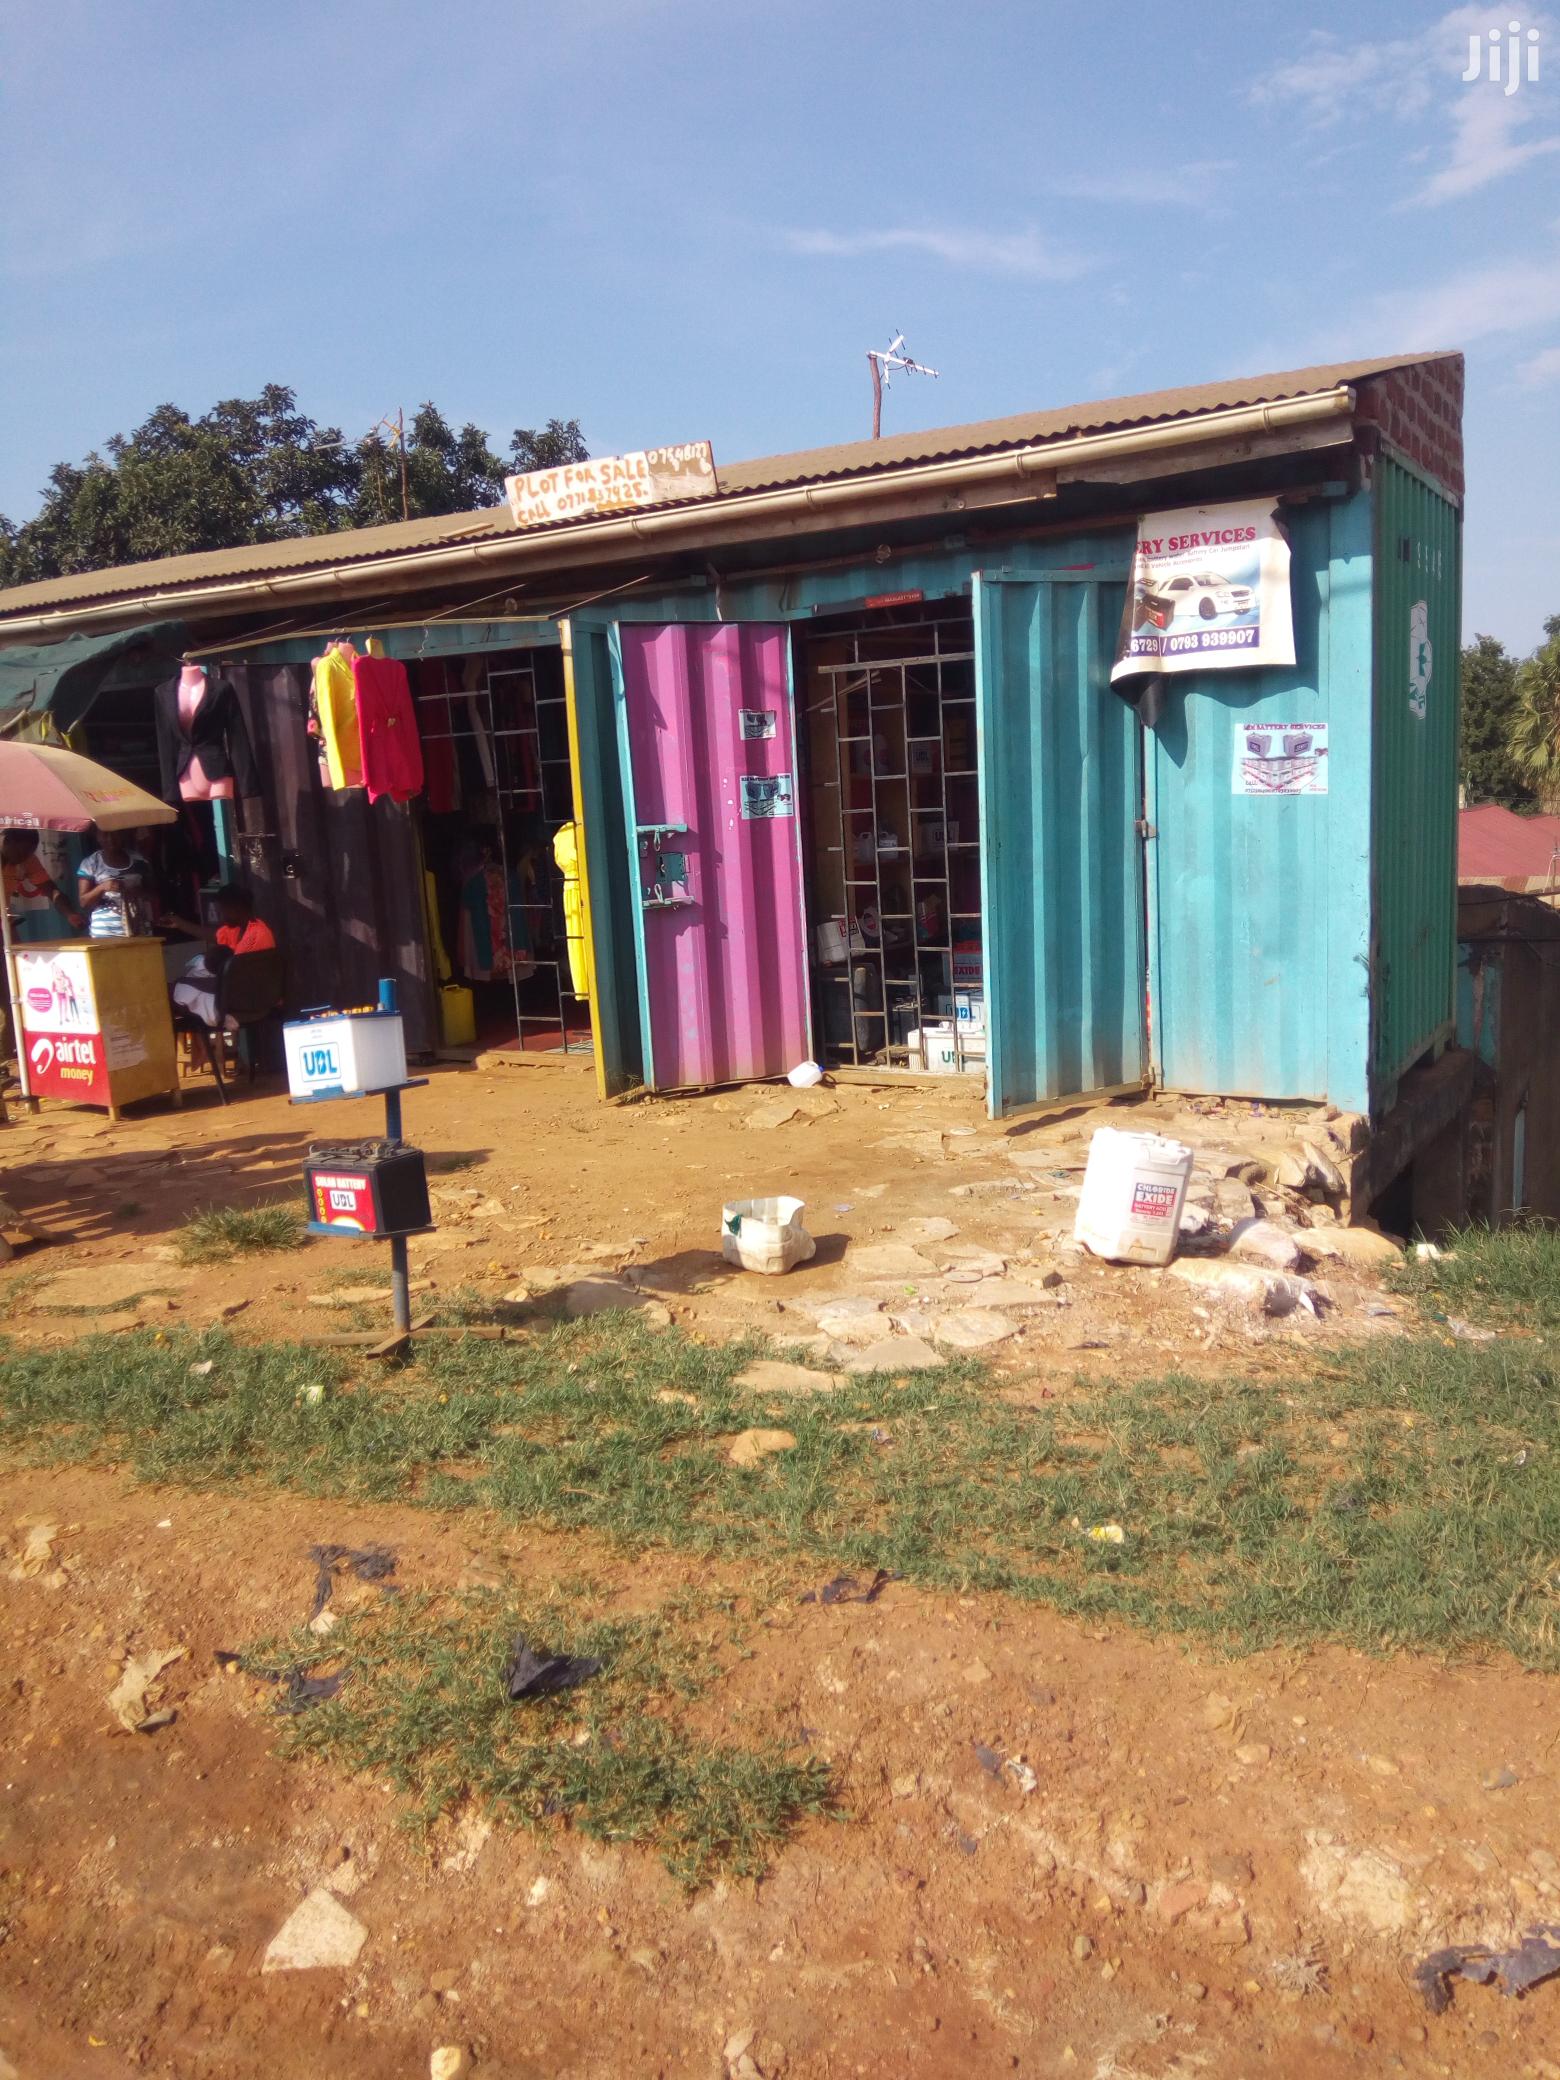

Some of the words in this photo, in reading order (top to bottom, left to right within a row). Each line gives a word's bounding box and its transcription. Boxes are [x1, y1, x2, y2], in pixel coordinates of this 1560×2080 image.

[514, 472, 558, 500] PLOT
[564, 468, 597, 489] FOR
[601, 459, 647, 485] SALE
[517, 504, 552, 524] CALL
[1168, 527, 1256, 551] SERVICES
[1170, 634, 1199, 651] 0793
[1201, 629, 1255, 647] 939907
[55, 1036, 96, 1065] airtel
[303, 1049, 338, 1076] UBL
[60, 1067, 94, 1086] money
[1135, 1191, 1174, 1205] EXIDE
[1137, 1183, 1175, 1194] CHLORIDE
